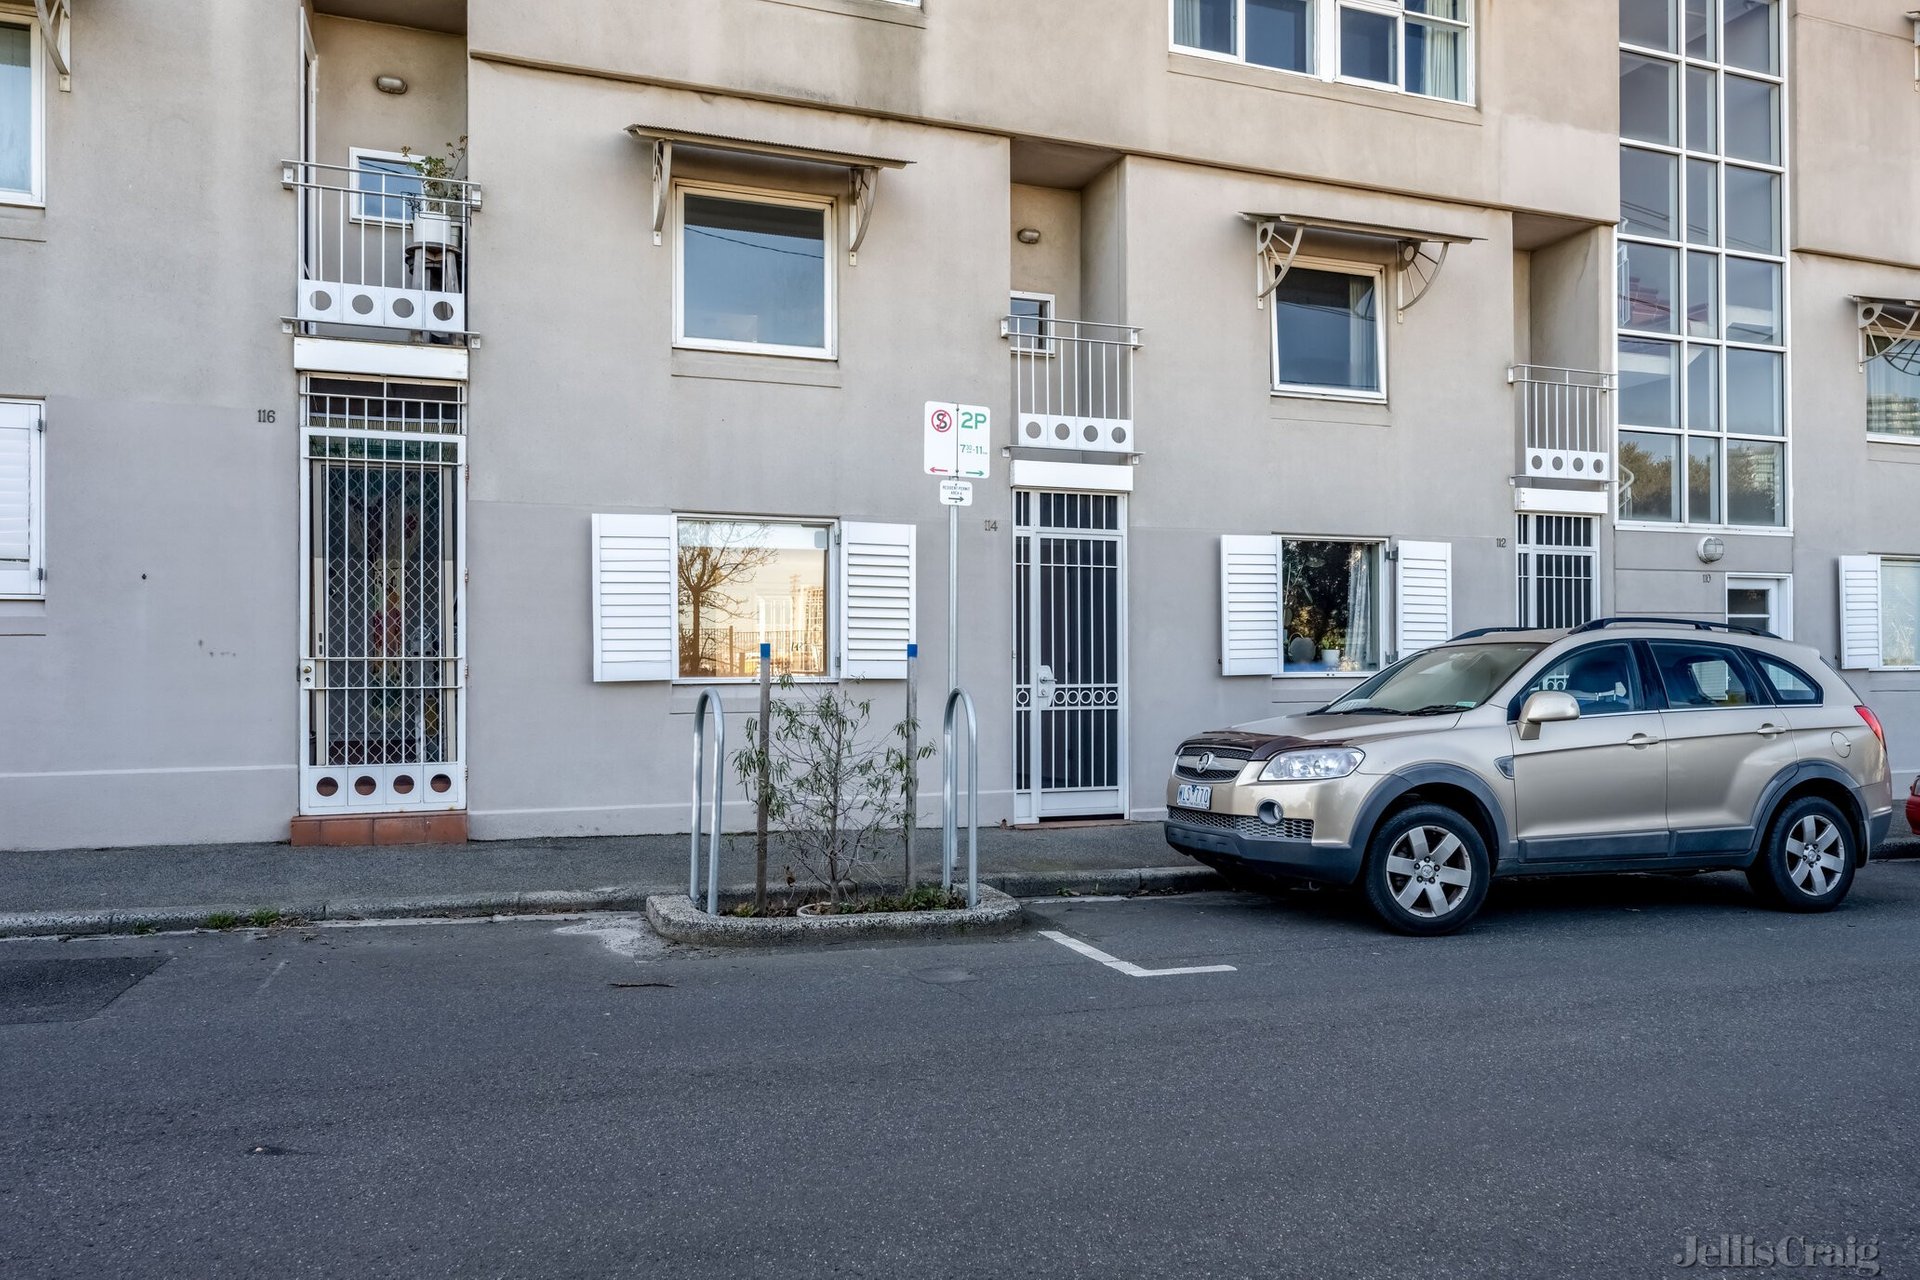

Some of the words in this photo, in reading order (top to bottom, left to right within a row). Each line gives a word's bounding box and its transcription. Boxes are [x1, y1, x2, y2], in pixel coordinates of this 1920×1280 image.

[257, 409, 276, 424] 116
[961, 411, 987, 430] 2P
[985, 520, 998, 531] 114
[1496, 537, 1507, 548] 112
[1195, 787, 1209, 803] 770
